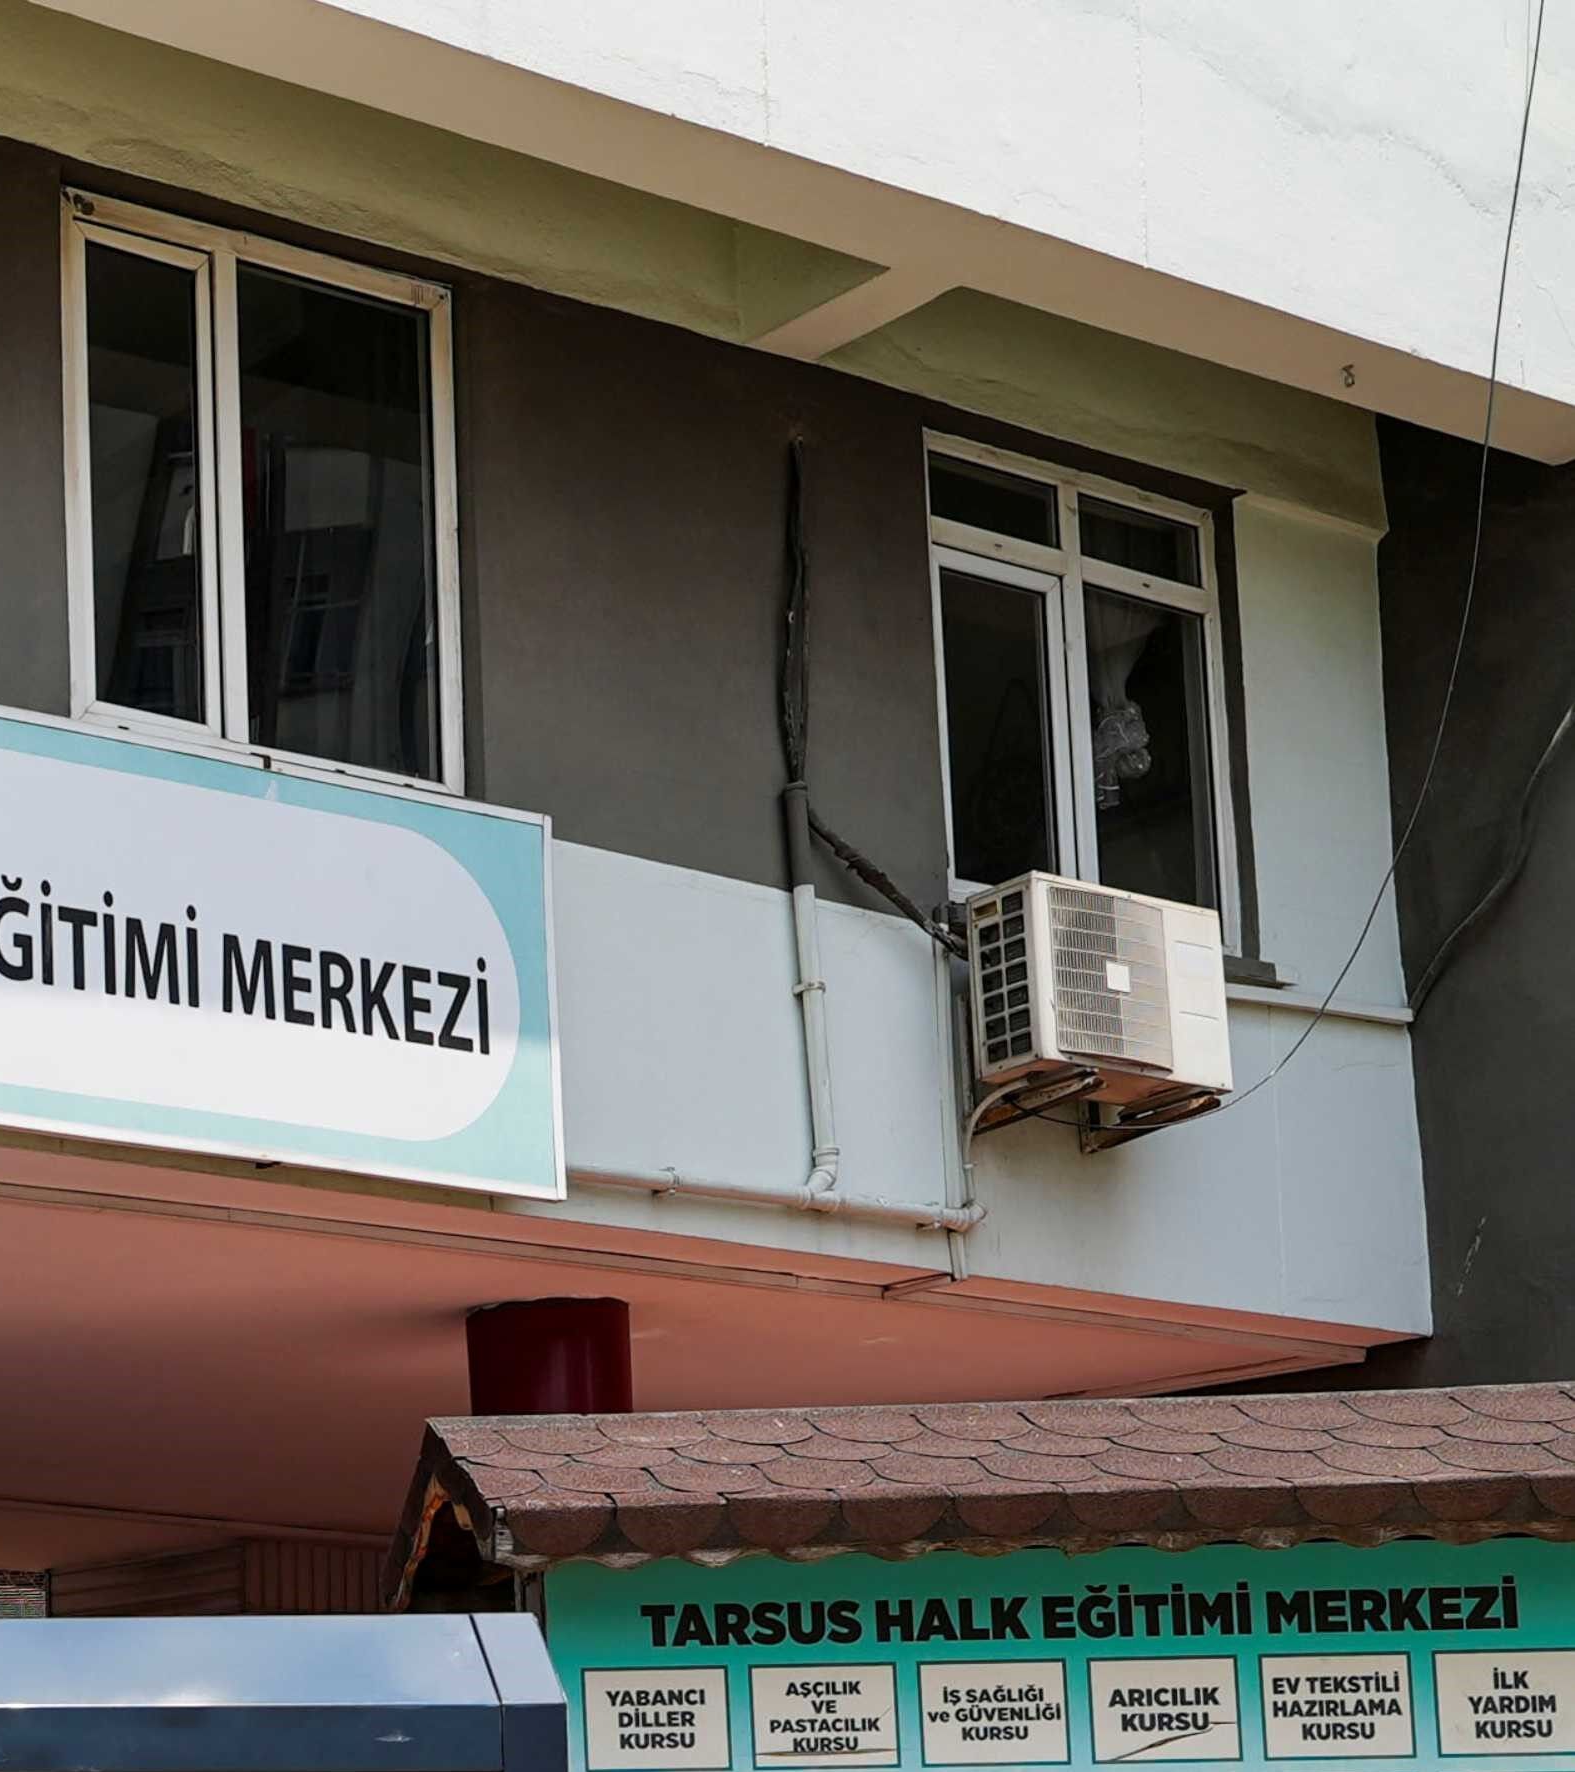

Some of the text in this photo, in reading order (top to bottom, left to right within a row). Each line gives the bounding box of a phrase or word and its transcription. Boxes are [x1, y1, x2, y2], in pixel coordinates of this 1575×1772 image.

[221, 932, 492, 1056] MERKEZİ
[640, 1575, 1520, 1649] TARSUS HALK EĞİTİMİ MERKEZİ
[1271, 1670, 1401, 1696] EV TEKSTİLİ
[1492, 1666, 1529, 1690] İLK
[605, 1688, 707, 1708] YABANCI
[785, 1680, 862, 1700] AŞÇILIK
[942, 1684, 1045, 1706] İŞ SAĞLIĞI
[1108, 1686, 1220, 1708] ARICILIK
[811, 1699, 838, 1716] VE
[927, 1702, 1062, 1723] ve GÜVENLİĞİ
[1272, 1698, 1403, 1718] HAZIRLAMA
[1467, 1694, 1557, 1715] YARDIM
[617, 1707, 696, 1728] DİLLER
[769, 1716, 881, 1734] PASTACILIK
[1121, 1711, 1210, 1733] KURSU
[961, 1725, 1029, 1742] KURSU
[1301, 1721, 1376, 1741] KURSU
[1474, 1718, 1554, 1740] KURSU
[619, 1731, 696, 1751] KURSU
[792, 1736, 860, 1754] KURSU
